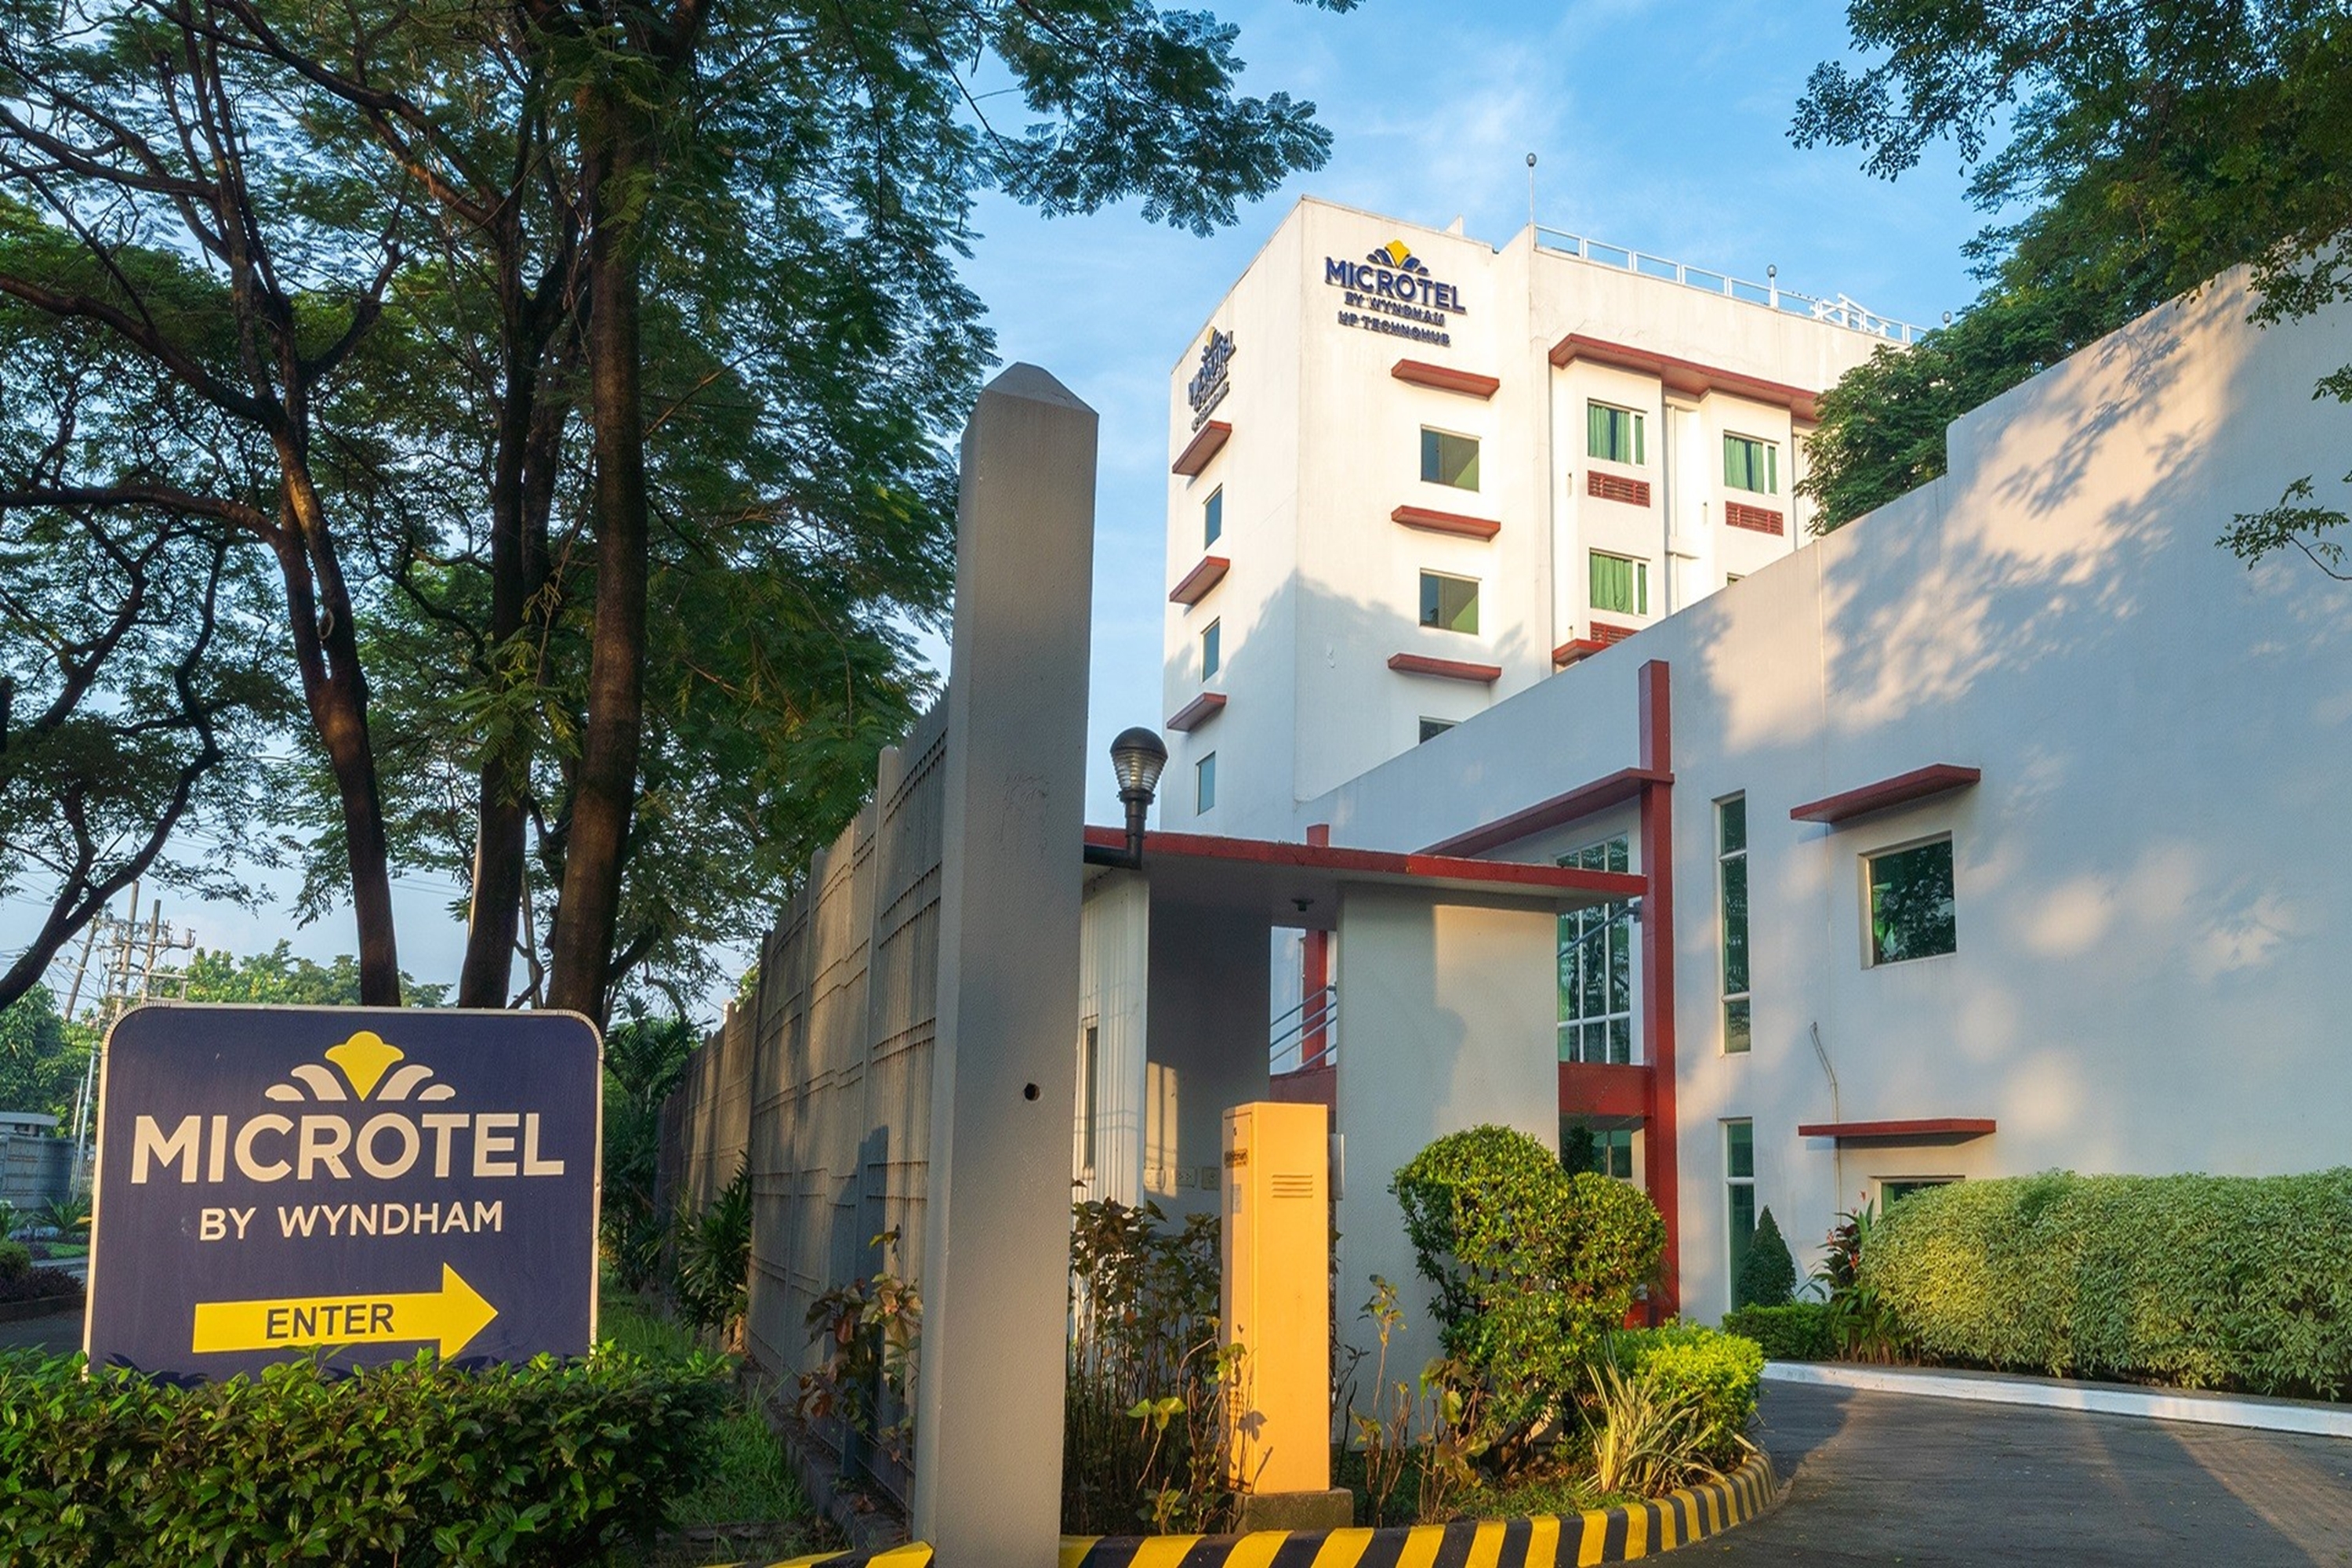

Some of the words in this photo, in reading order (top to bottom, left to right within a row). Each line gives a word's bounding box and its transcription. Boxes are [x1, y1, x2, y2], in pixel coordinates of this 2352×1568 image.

[1325, 256, 1466, 314] MICROTEL
[1345, 292, 1363, 308] BY
[1369, 297, 1445, 327] WYNDHAM
[131, 1112, 564, 1184] MICROTEL
[199, 1207, 257, 1242] BY
[278, 1200, 503, 1237] WYNDHAM
[265, 1302, 395, 1340] ENTER
